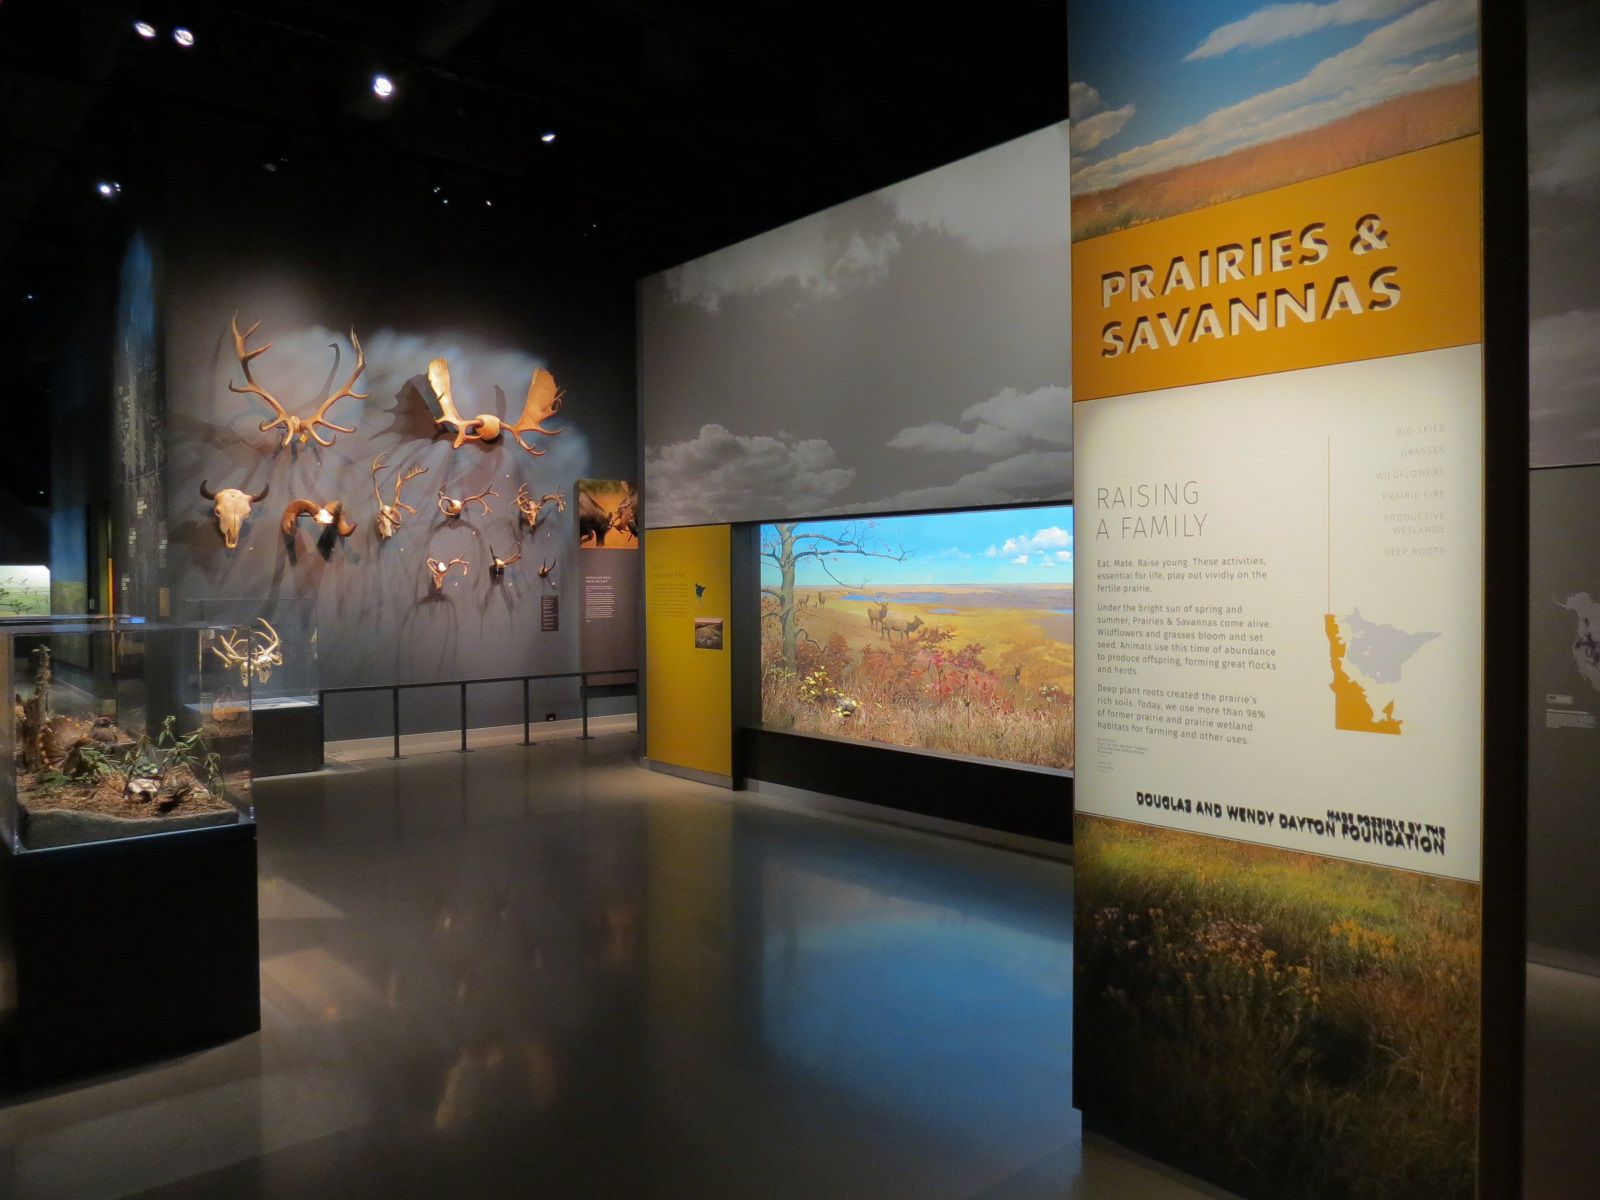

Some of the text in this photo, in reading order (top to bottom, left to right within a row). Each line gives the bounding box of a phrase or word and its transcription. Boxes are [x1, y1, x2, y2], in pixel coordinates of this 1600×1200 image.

[1101, 213, 1390, 308] PRAIRIES &
[1101, 266, 1401, 358] SAVANNAS
[1397, 424, 1445, 436] BIG SKIES
[1401, 446, 1445, 456] GRASSES
[1376, 468, 1445, 480] WILDFLOWERS
[1097, 481, 1199, 510] RAISING
[1382, 490, 1444, 500] PRAIRIE FIRE
[1384, 512, 1445, 521] PRODUCTIVE
[1096, 513, 1208, 540] A FAMILY
[1393, 525, 1445, 534] WETLANDS
[1384, 547, 1445, 556] DEEP ROOTS
[1114, 559, 1135, 567] Mate.
[1138, 559, 1159, 567] Raise
[1162, 558, 1190, 568] young.
[1193, 558, 1219, 566] These
[1221, 557, 1266, 566] activities,
[1097, 572, 1133, 580] essential
[1135, 571, 1147, 579] for
[1149, 571, 1165, 580] life,
[1167, 572, 1185, 581] play
[1205, 571, 1234, 580] vividly
[1252, 571, 1267, 579] the
[1097, 584, 1152, 594] fertile prairie.
[1097, 604, 1121, 612] Under
[1123, 604, 1136, 612] the
[1138, 604, 1164, 614] bright
[1183, 605, 1192, 613] of
[1195, 606, 1223, 615] spring
[1225, 606, 1243, 614] and
[1097, 617, 1130, 625] summer,
[1132, 617, 1164, 625] Prairies
[1167, 618, 1173, 626] &
[1176, 618, 1217, 626] Savannas
[1247, 620, 1272, 628] alive.
[1097, 629, 1264, 642] Wildflowers and grasses bloom and set
[1120, 642, 1152, 651] Animals
[1171, 644, 1188, 653] this
[1190, 645, 1210, 653] time
[1213, 646, 1222, 654] of
[1224, 646, 1276, 656] abundance
[1108, 655, 1140, 664] produce
[1142, 655, 1182, 666] offspring,
[1185, 657, 1220, 669] forming
[1222, 659, 1246, 669] great
[1248, 660, 1277, 670] flocks
[1097, 666, 1139, 675] and herds.
[1097, 684, 1257, 705] Deep plant roots created the prairie's
[1097, 697, 1266, 719] rich soils. Today, we use more than 98%
[1097, 709, 1253, 731] of former prairie and prairie wetland
[1097, 721, 1249, 745] habitats for farming and other uses.
[1136, 791, 1445, 855] DOUGLAS AND WENDY DAYTON FOUNDATION
[1327, 810, 1446, 840] MADE POSSIBLE BY THE
